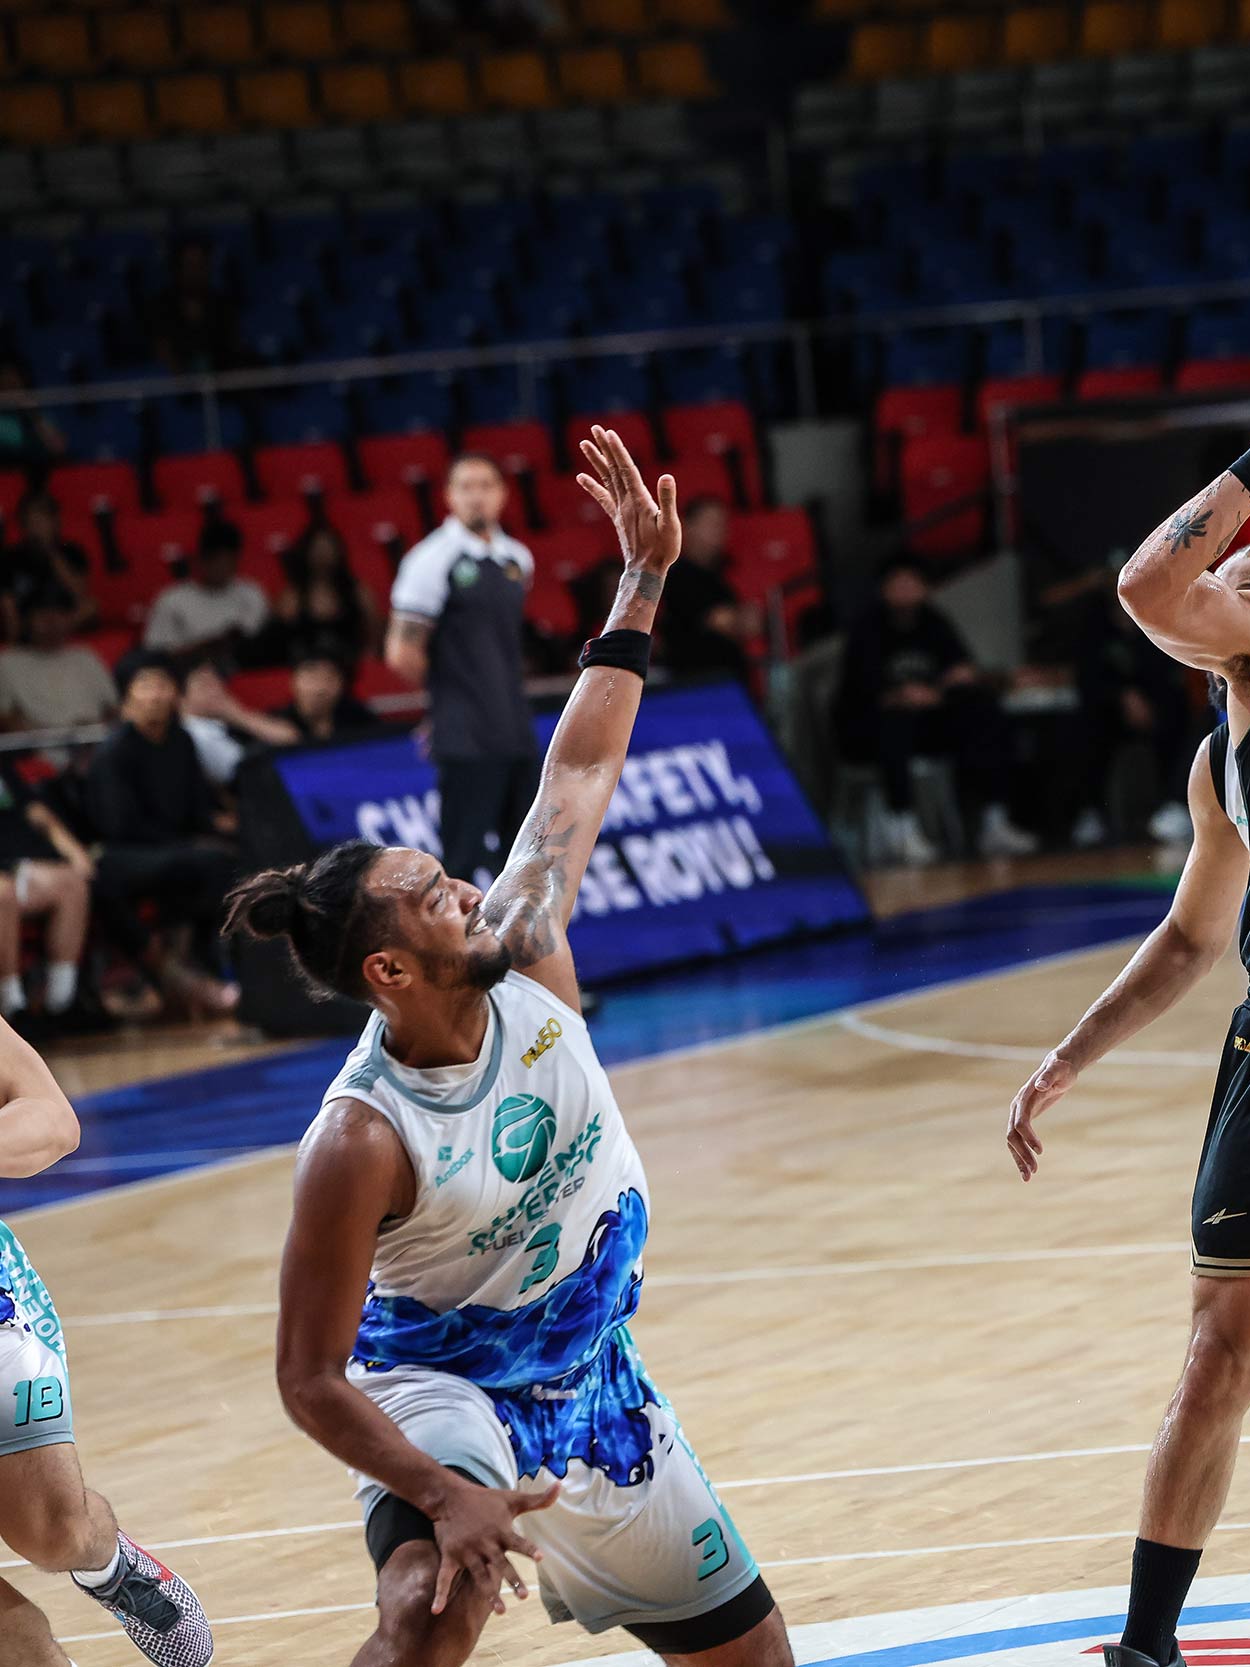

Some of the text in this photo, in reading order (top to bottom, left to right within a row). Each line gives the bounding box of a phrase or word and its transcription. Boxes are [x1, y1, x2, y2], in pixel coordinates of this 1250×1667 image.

[600, 738, 762, 831] AFETY,
[468, 1111, 603, 1236] OENIX
[519, 1222, 562, 1295] 3
[4, 1240, 68, 1372] HOENIX
[13, 1376, 63, 1427] 18
[692, 1518, 730, 1581] 3
